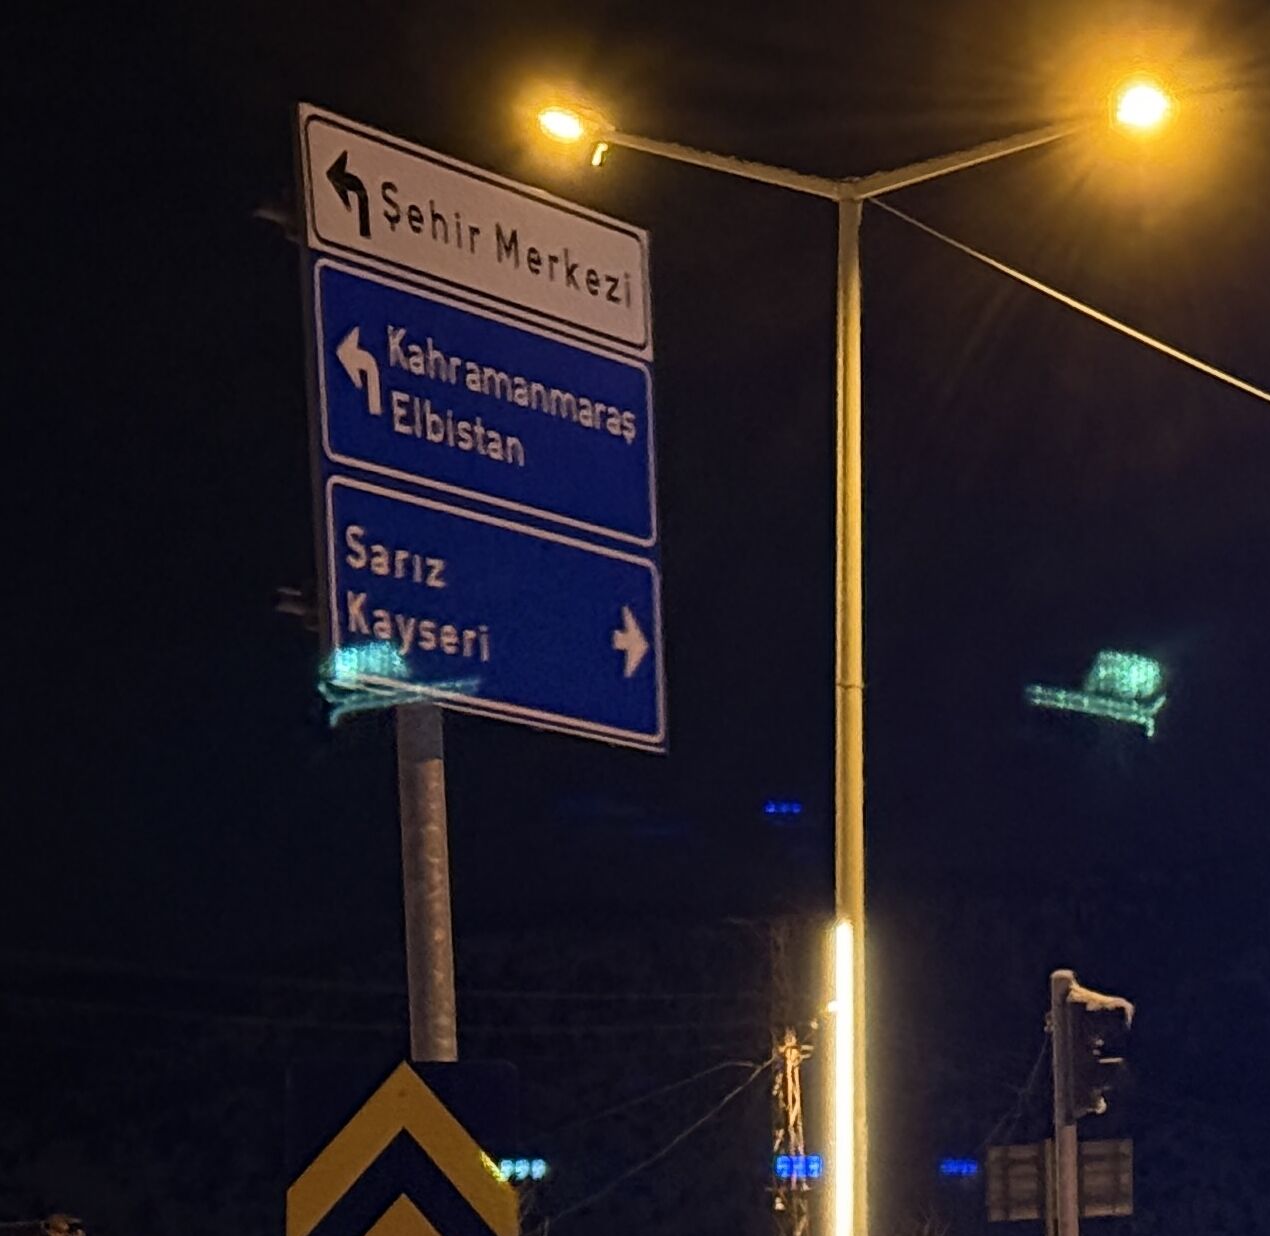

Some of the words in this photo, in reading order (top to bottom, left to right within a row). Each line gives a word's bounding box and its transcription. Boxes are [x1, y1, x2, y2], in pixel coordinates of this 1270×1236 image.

[380, 181, 482, 255] Şehir
[495, 223, 633, 309] Merkezi
[386, 324, 637, 445] Kahramanmaraş
[392, 391, 526, 467] Elbistan
[346, 524, 448, 588] Sarız
[348, 590, 490, 662] Kayseri
